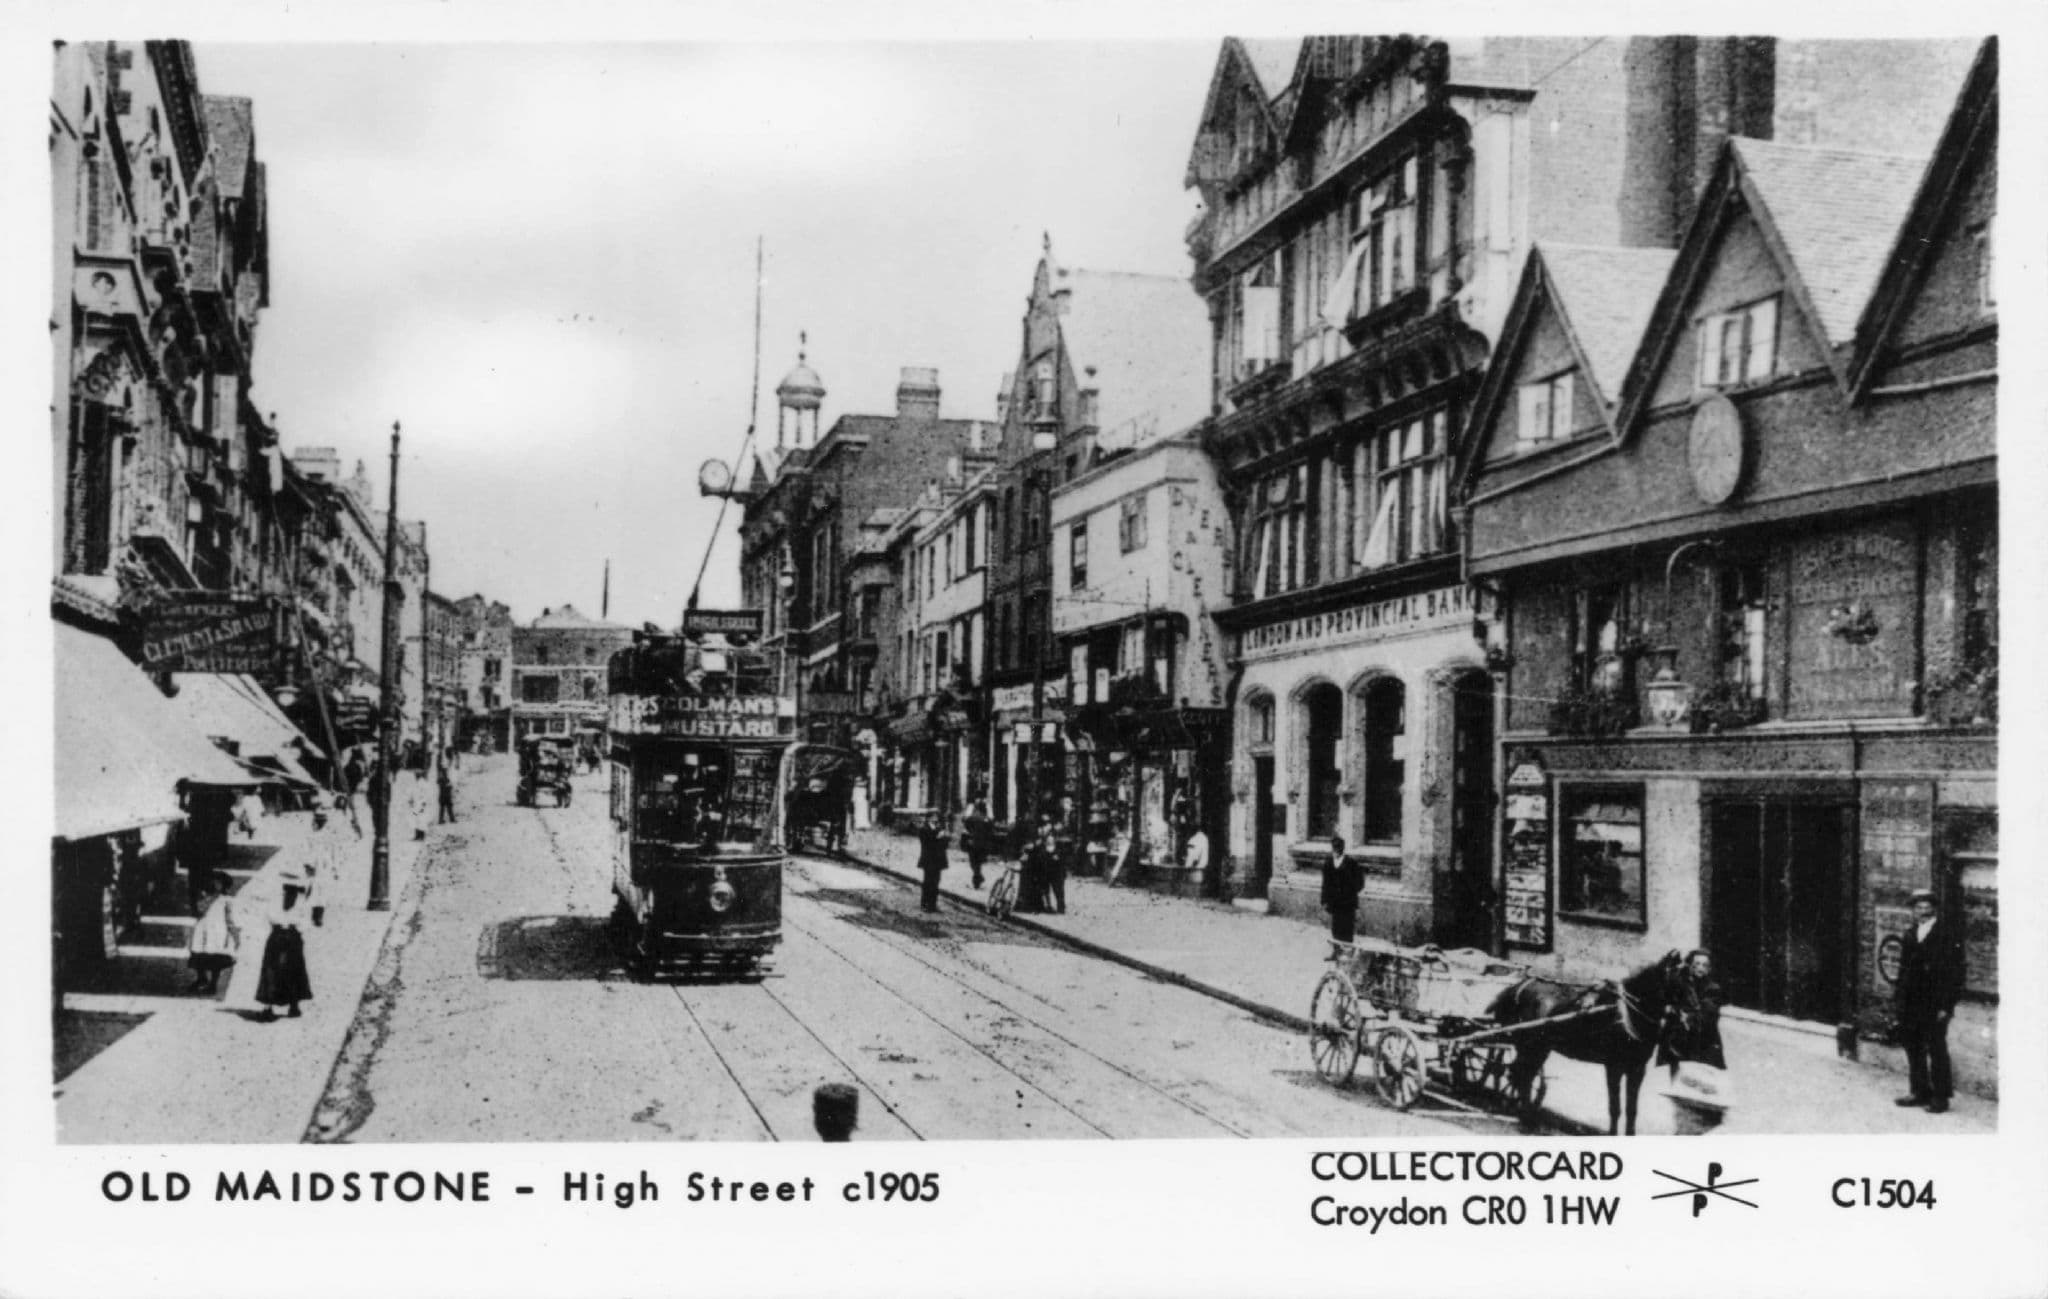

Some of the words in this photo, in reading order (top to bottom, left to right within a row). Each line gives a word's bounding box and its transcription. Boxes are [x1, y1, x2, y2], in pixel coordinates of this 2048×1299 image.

[1246, 624, 1292, 651] LONDON
[1296, 615, 1322, 640] AND
[1326, 597, 1420, 635] PROVINCIAL
[1426, 584, 1476, 618] BANK
[664, 696, 775, 715] COLMAN'S
[666, 718, 775, 737] MUSTARD
